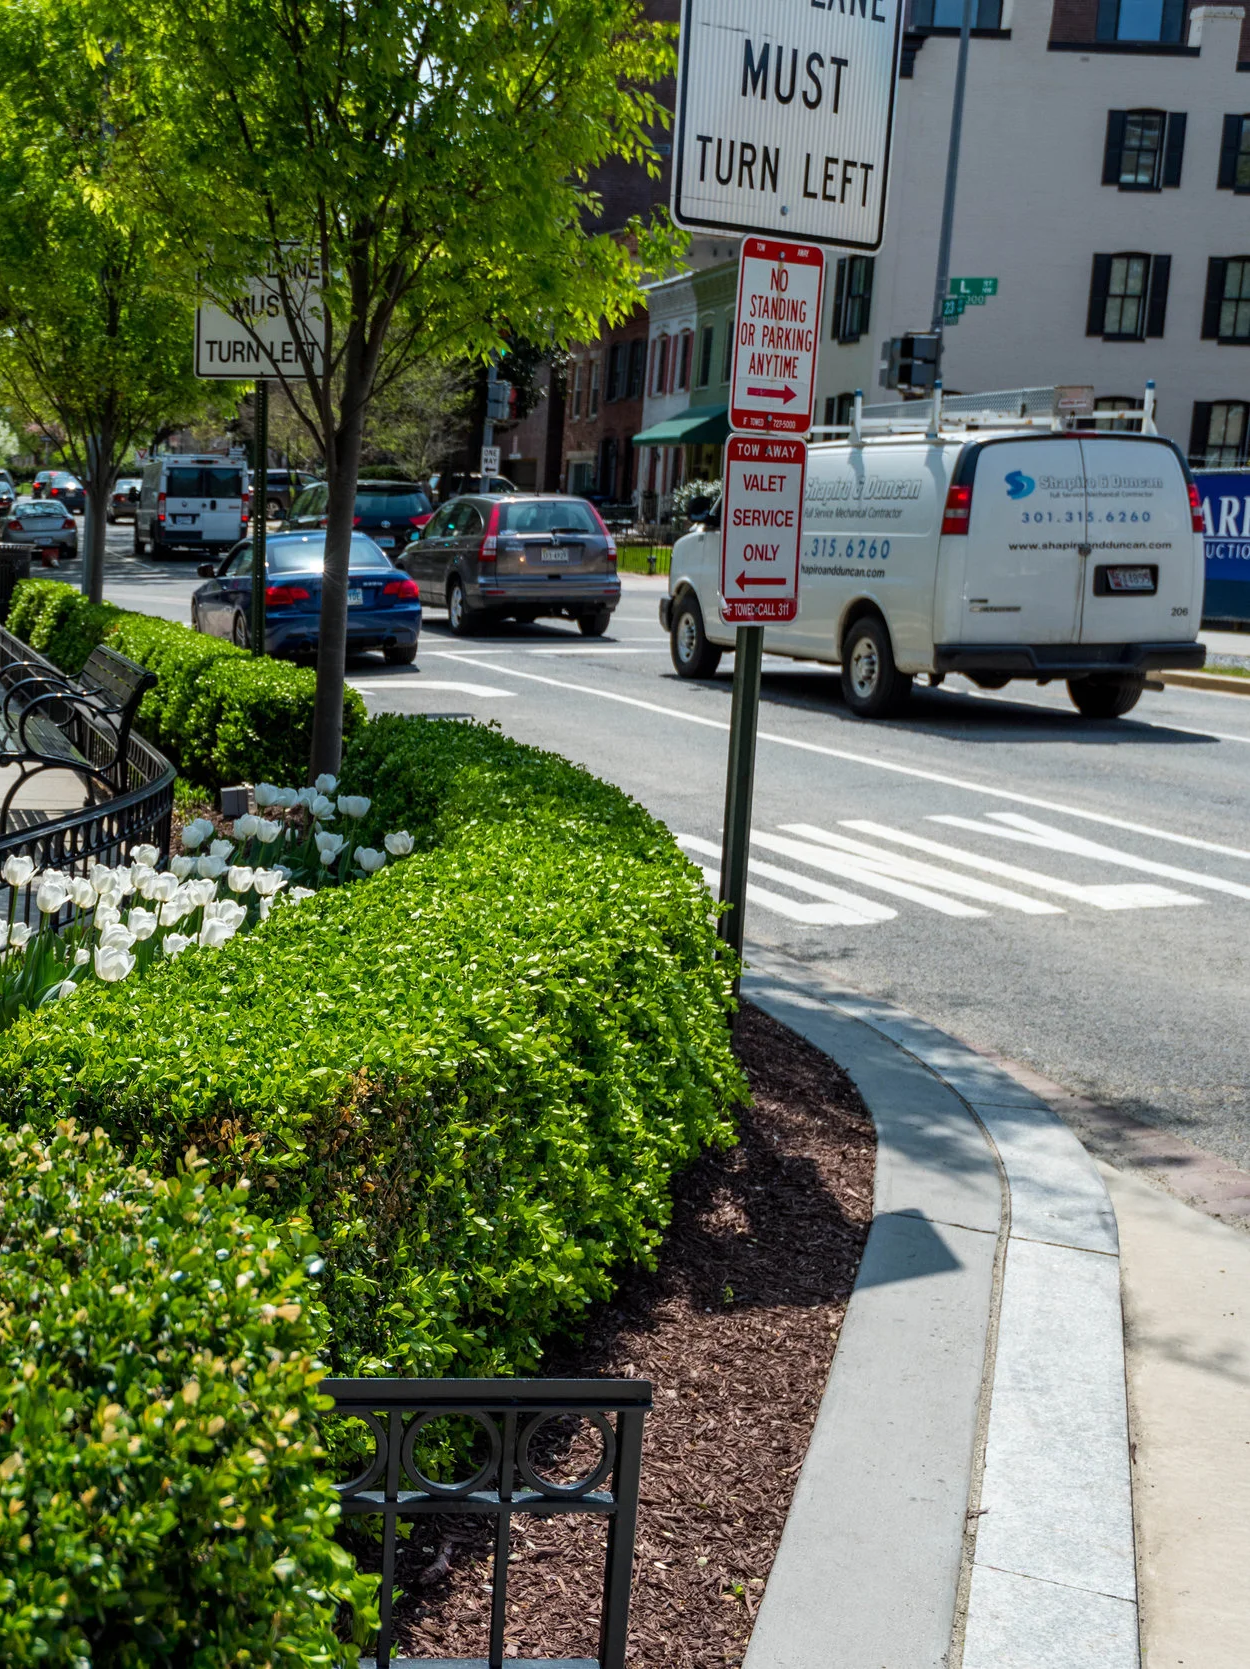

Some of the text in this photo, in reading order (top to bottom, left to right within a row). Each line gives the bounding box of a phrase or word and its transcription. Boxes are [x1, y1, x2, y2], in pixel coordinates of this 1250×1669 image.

[741, 39, 849, 114] MUST
[696, 134, 874, 207] TURN LEFT
[770, 268, 789, 293] NO
[960, 280, 971, 293] L
[749, 294, 807, 324] STANDING
[740, 322, 813, 353] OR PARKING
[205, 340, 260, 363] TURN
[748, 352, 799, 379] ANYTIME
[737, 443, 797, 458] TOW AWAY
[743, 474, 786, 492] VALET
[732, 508, 794, 528] SERVICE
[1021, 511, 1151, 524] 301.315.6260
[743, 544, 780, 562] ONLY
[757, 603, 776, 616] CALL
[778, 603, 789, 616] 311
